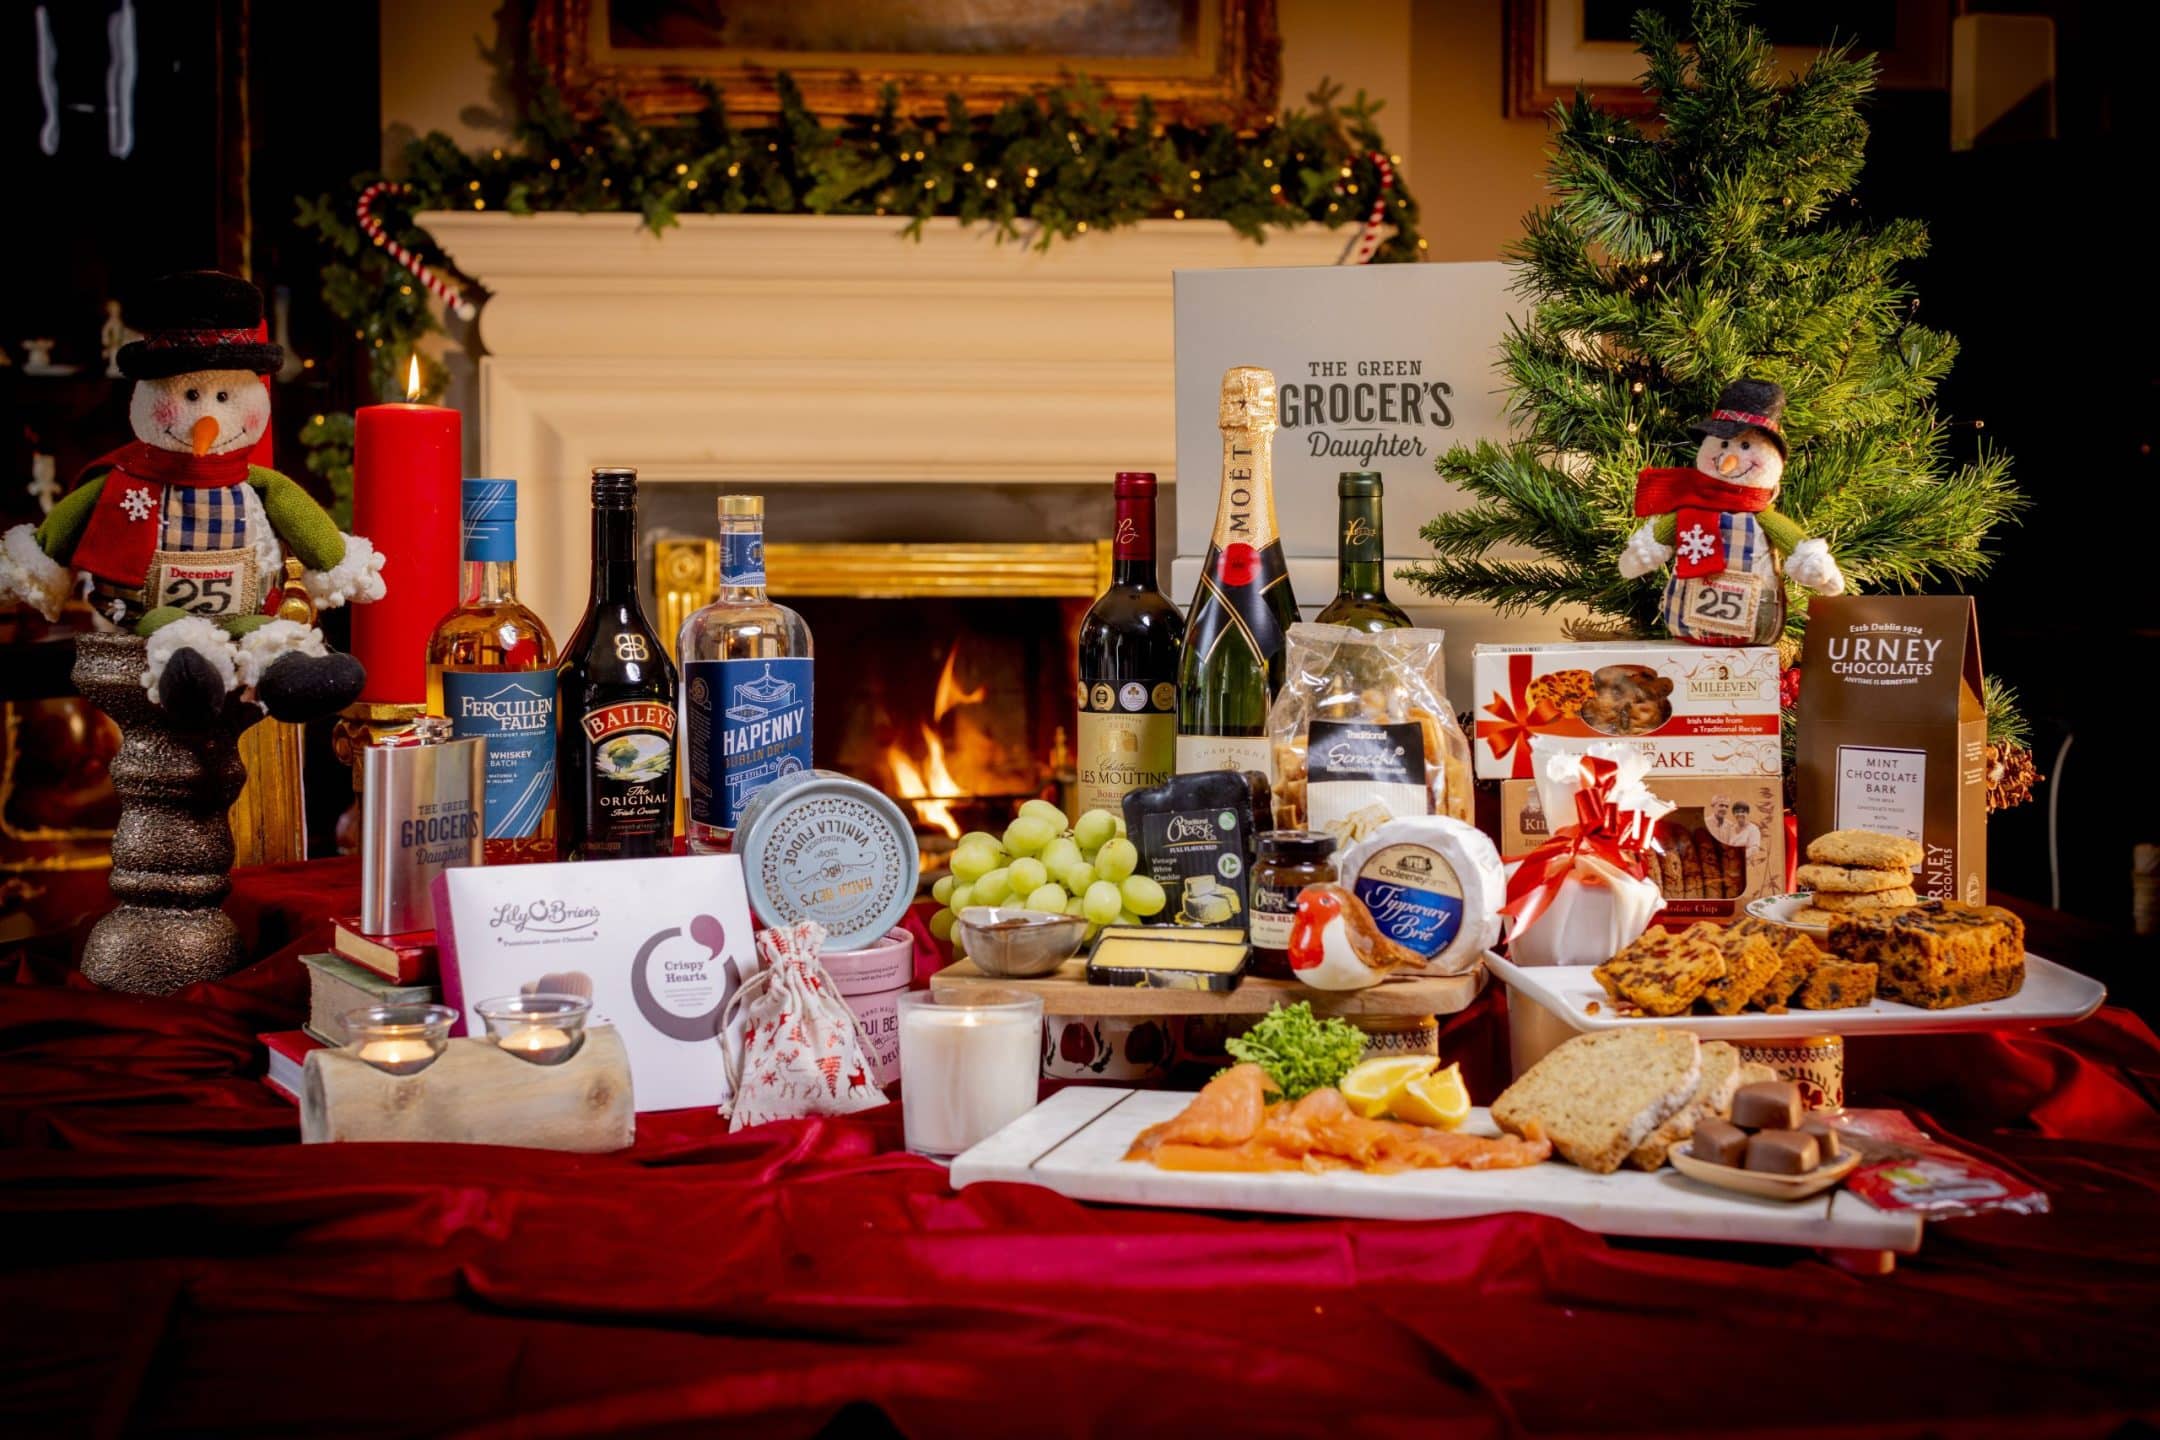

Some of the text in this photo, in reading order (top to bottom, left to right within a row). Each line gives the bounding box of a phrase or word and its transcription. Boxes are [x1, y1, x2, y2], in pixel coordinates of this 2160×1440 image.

[1308, 360, 1422, 377] THE GREEN
[1279, 382, 1454, 430] GROCER'S
[1307, 431, 1427, 467] Daughter
[1229, 444, 1253, 533] MOËT
[170, 567, 235, 579] December
[165, 577, 233, 614] 25
[1695, 587, 1743, 620] 25
[1871, 623, 1901, 631] Dublin
[1903, 625, 1923, 635] 1924
[1828, 637, 1942, 662] URNEY
[1831, 662, 1933, 676] CHOCOLATES
[1690, 681, 1757, 693] MILEEVEN
[461, 696, 552, 721] FERCULLEN
[501, 715, 547, 731] FALLS
[591, 706, 674, 734] BAILEYS
[1703, 717, 1724, 725] Made
[723, 707, 805, 757] HA'PENNY
[1699, 725, 1737, 733] Traditional
[490, 750, 532, 760] WHISKEY
[768, 743, 784, 756] DRY
[490, 759, 517, 767] BATCH
[1866, 758, 1898, 768] MINT
[1080, 769, 1168, 785] LES MOUTINS
[1846, 769, 1918, 783] CHOCOLATE
[627, 785, 650, 796] The
[1866, 783, 1896, 795] BARK
[600, 793, 668, 806] ORIGINAL
[418, 803, 438, 815] THE
[816, 820, 870, 848] VANILLA
[783, 828, 815, 867] FUDGE
[1153, 873, 1181, 881] Cheddar
[1927, 843, 1943, 900] RNEY
[1943, 848, 1953, 900] OCOLATES
[1365, 884, 1451, 932] Tipperary
[489, 903, 528, 933] Lily
[1391, 914, 1434, 941] Brie
[664, 960, 704, 972] Crispy
[665, 972, 707, 984] Hearts
